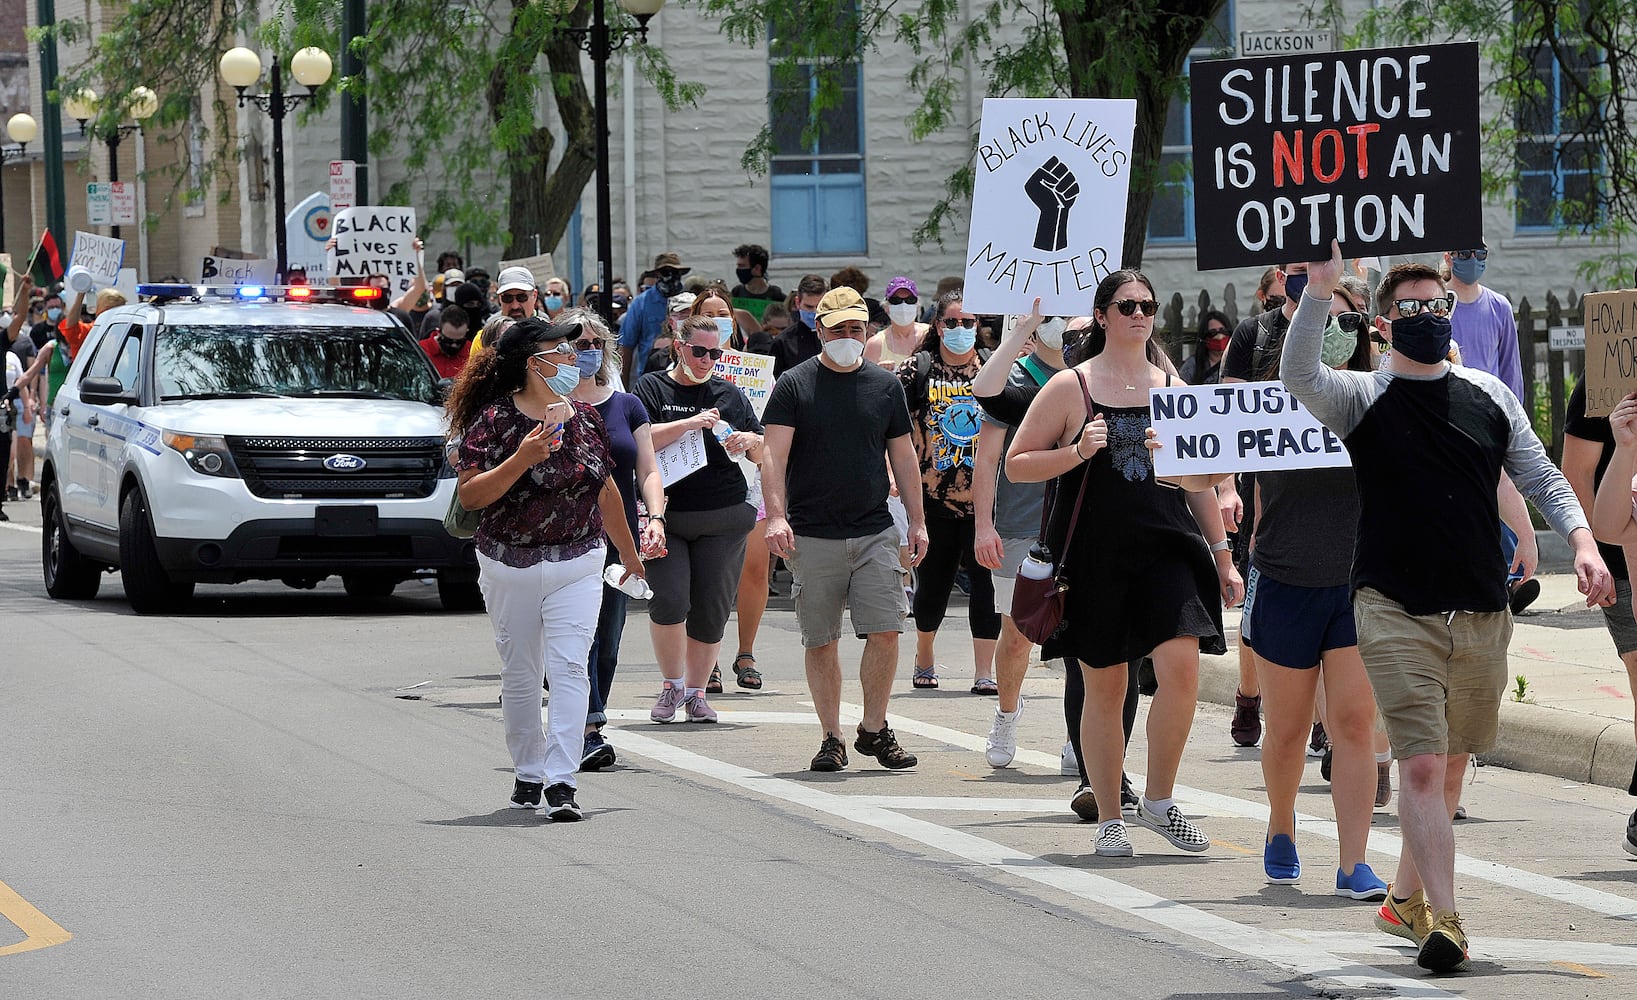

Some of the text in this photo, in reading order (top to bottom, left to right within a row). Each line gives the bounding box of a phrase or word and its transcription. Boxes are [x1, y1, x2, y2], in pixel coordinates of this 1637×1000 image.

[1246, 35, 1314, 51] JACKSON
[1219, 55, 1431, 125] SILENCE
[979, 112, 1127, 177] BLACK LIVES
[1215, 123, 1451, 189] IS NOT AN
[331, 163, 342, 174] NO
[336, 215, 412, 234] BLACK
[1236, 193, 1425, 251] OPTION
[79, 236, 121, 259] DRINK
[336, 238, 398, 257] Lives
[202, 257, 254, 279] Black
[336, 259, 416, 276] MATTER
[970, 242, 1112, 295] MATTER
[1591, 302, 1624, 335] HOW
[714, 363, 760, 377] ND THE DAY
[720, 354, 767, 368] LIVES BEGIN
[739, 375, 765, 388] SILENT
[749, 389, 766, 398] THAT
[1588, 387, 1616, 411] BLACK
[1152, 393, 1198, 421] NO
[680, 440, 688, 466] Racism
[690, 431, 702, 468] Tolerating
[1175, 426, 1342, 459] NO PEACE
[333, 457, 358, 468] Ford
[660, 450, 669, 478] Racism
